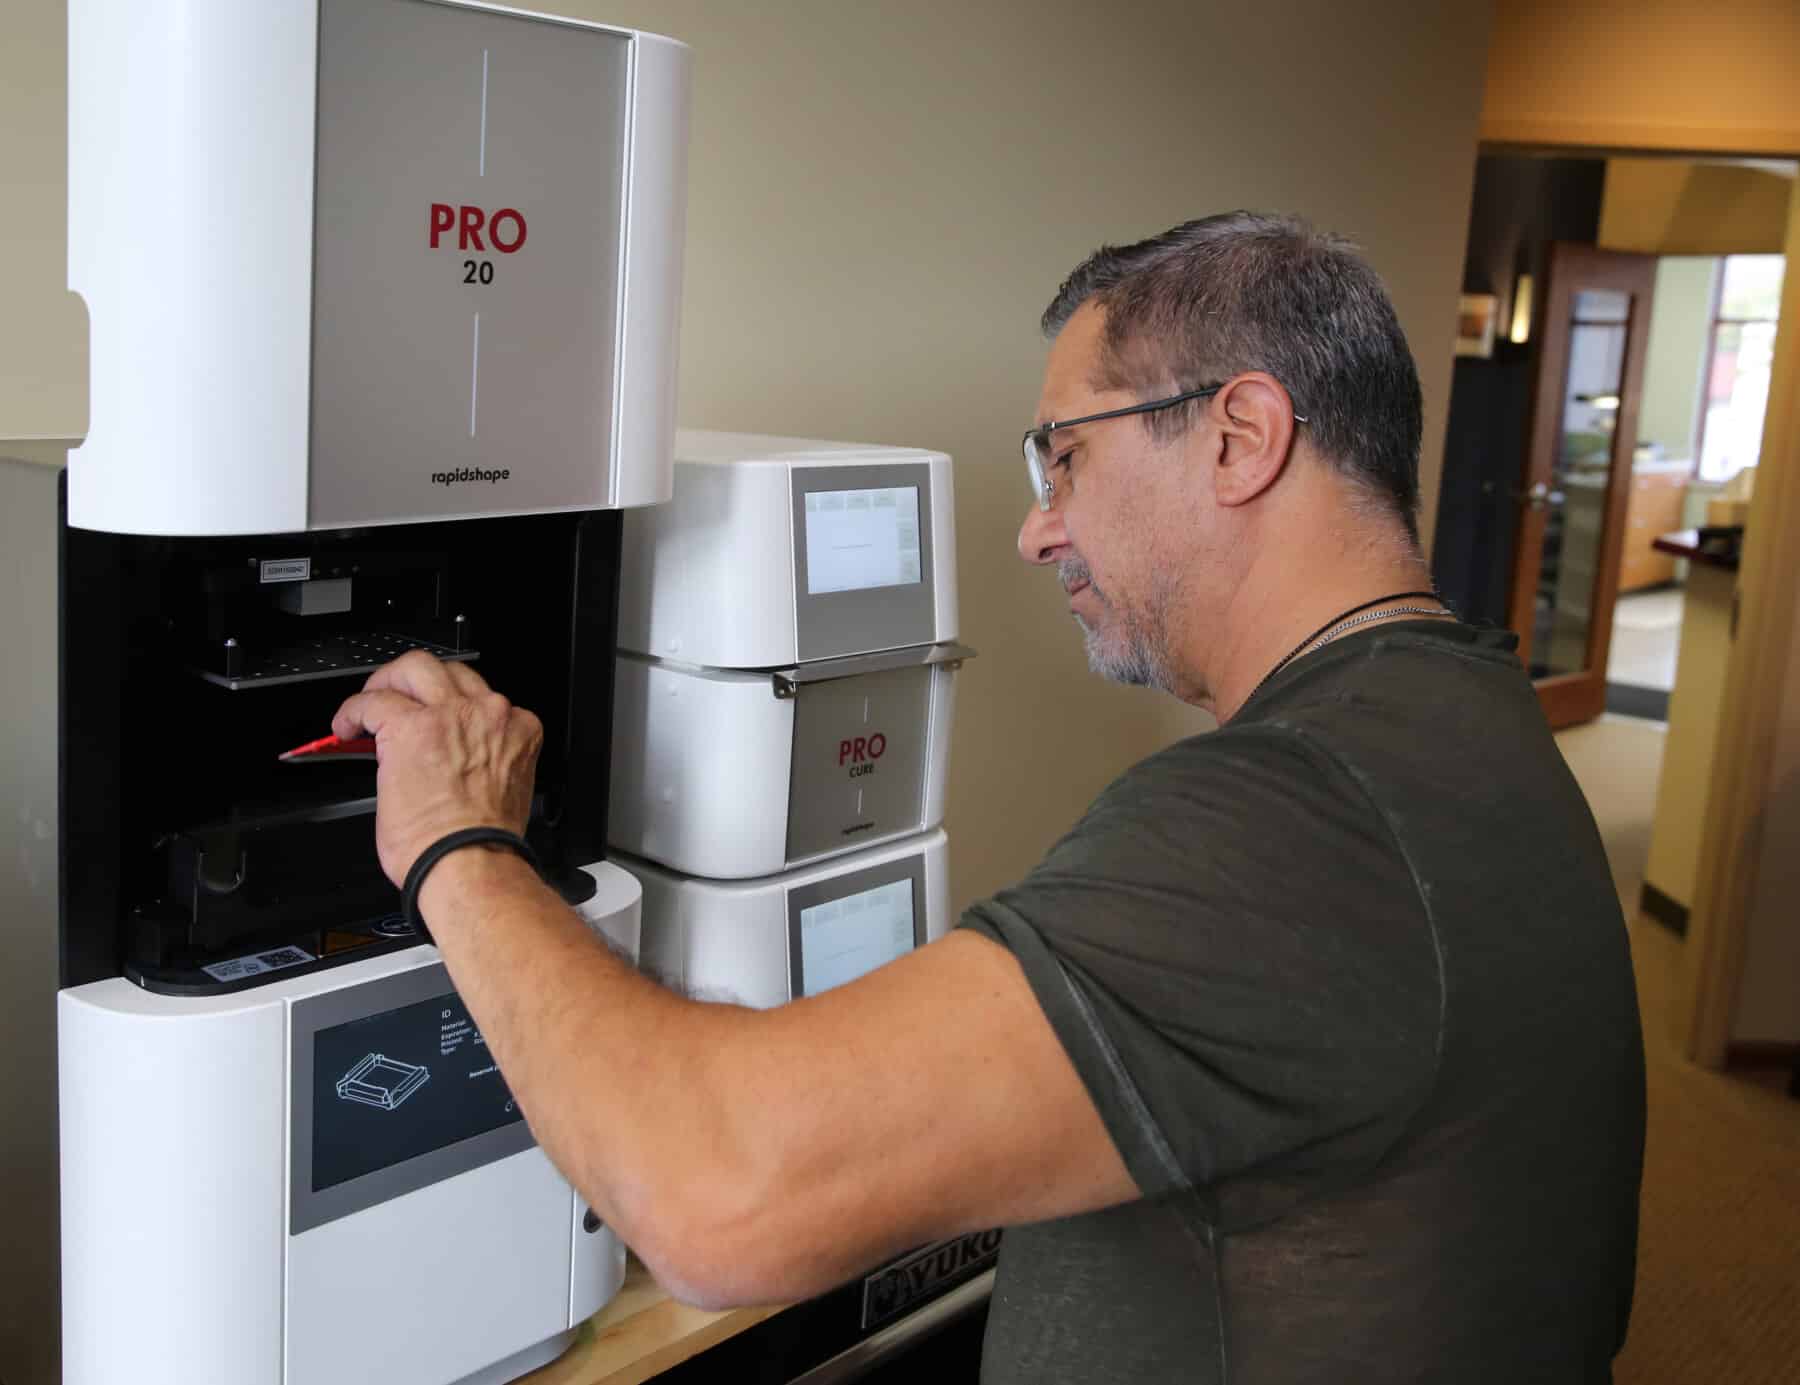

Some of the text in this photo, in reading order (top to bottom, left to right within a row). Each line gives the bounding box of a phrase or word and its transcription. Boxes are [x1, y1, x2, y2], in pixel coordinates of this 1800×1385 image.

[430, 203, 527, 254] PRO
[463, 260, 494, 285] 20
[431, 467, 510, 486] rapidshape
[839, 732, 886, 766] PRO
[441, 1008, 452, 1019] ID
